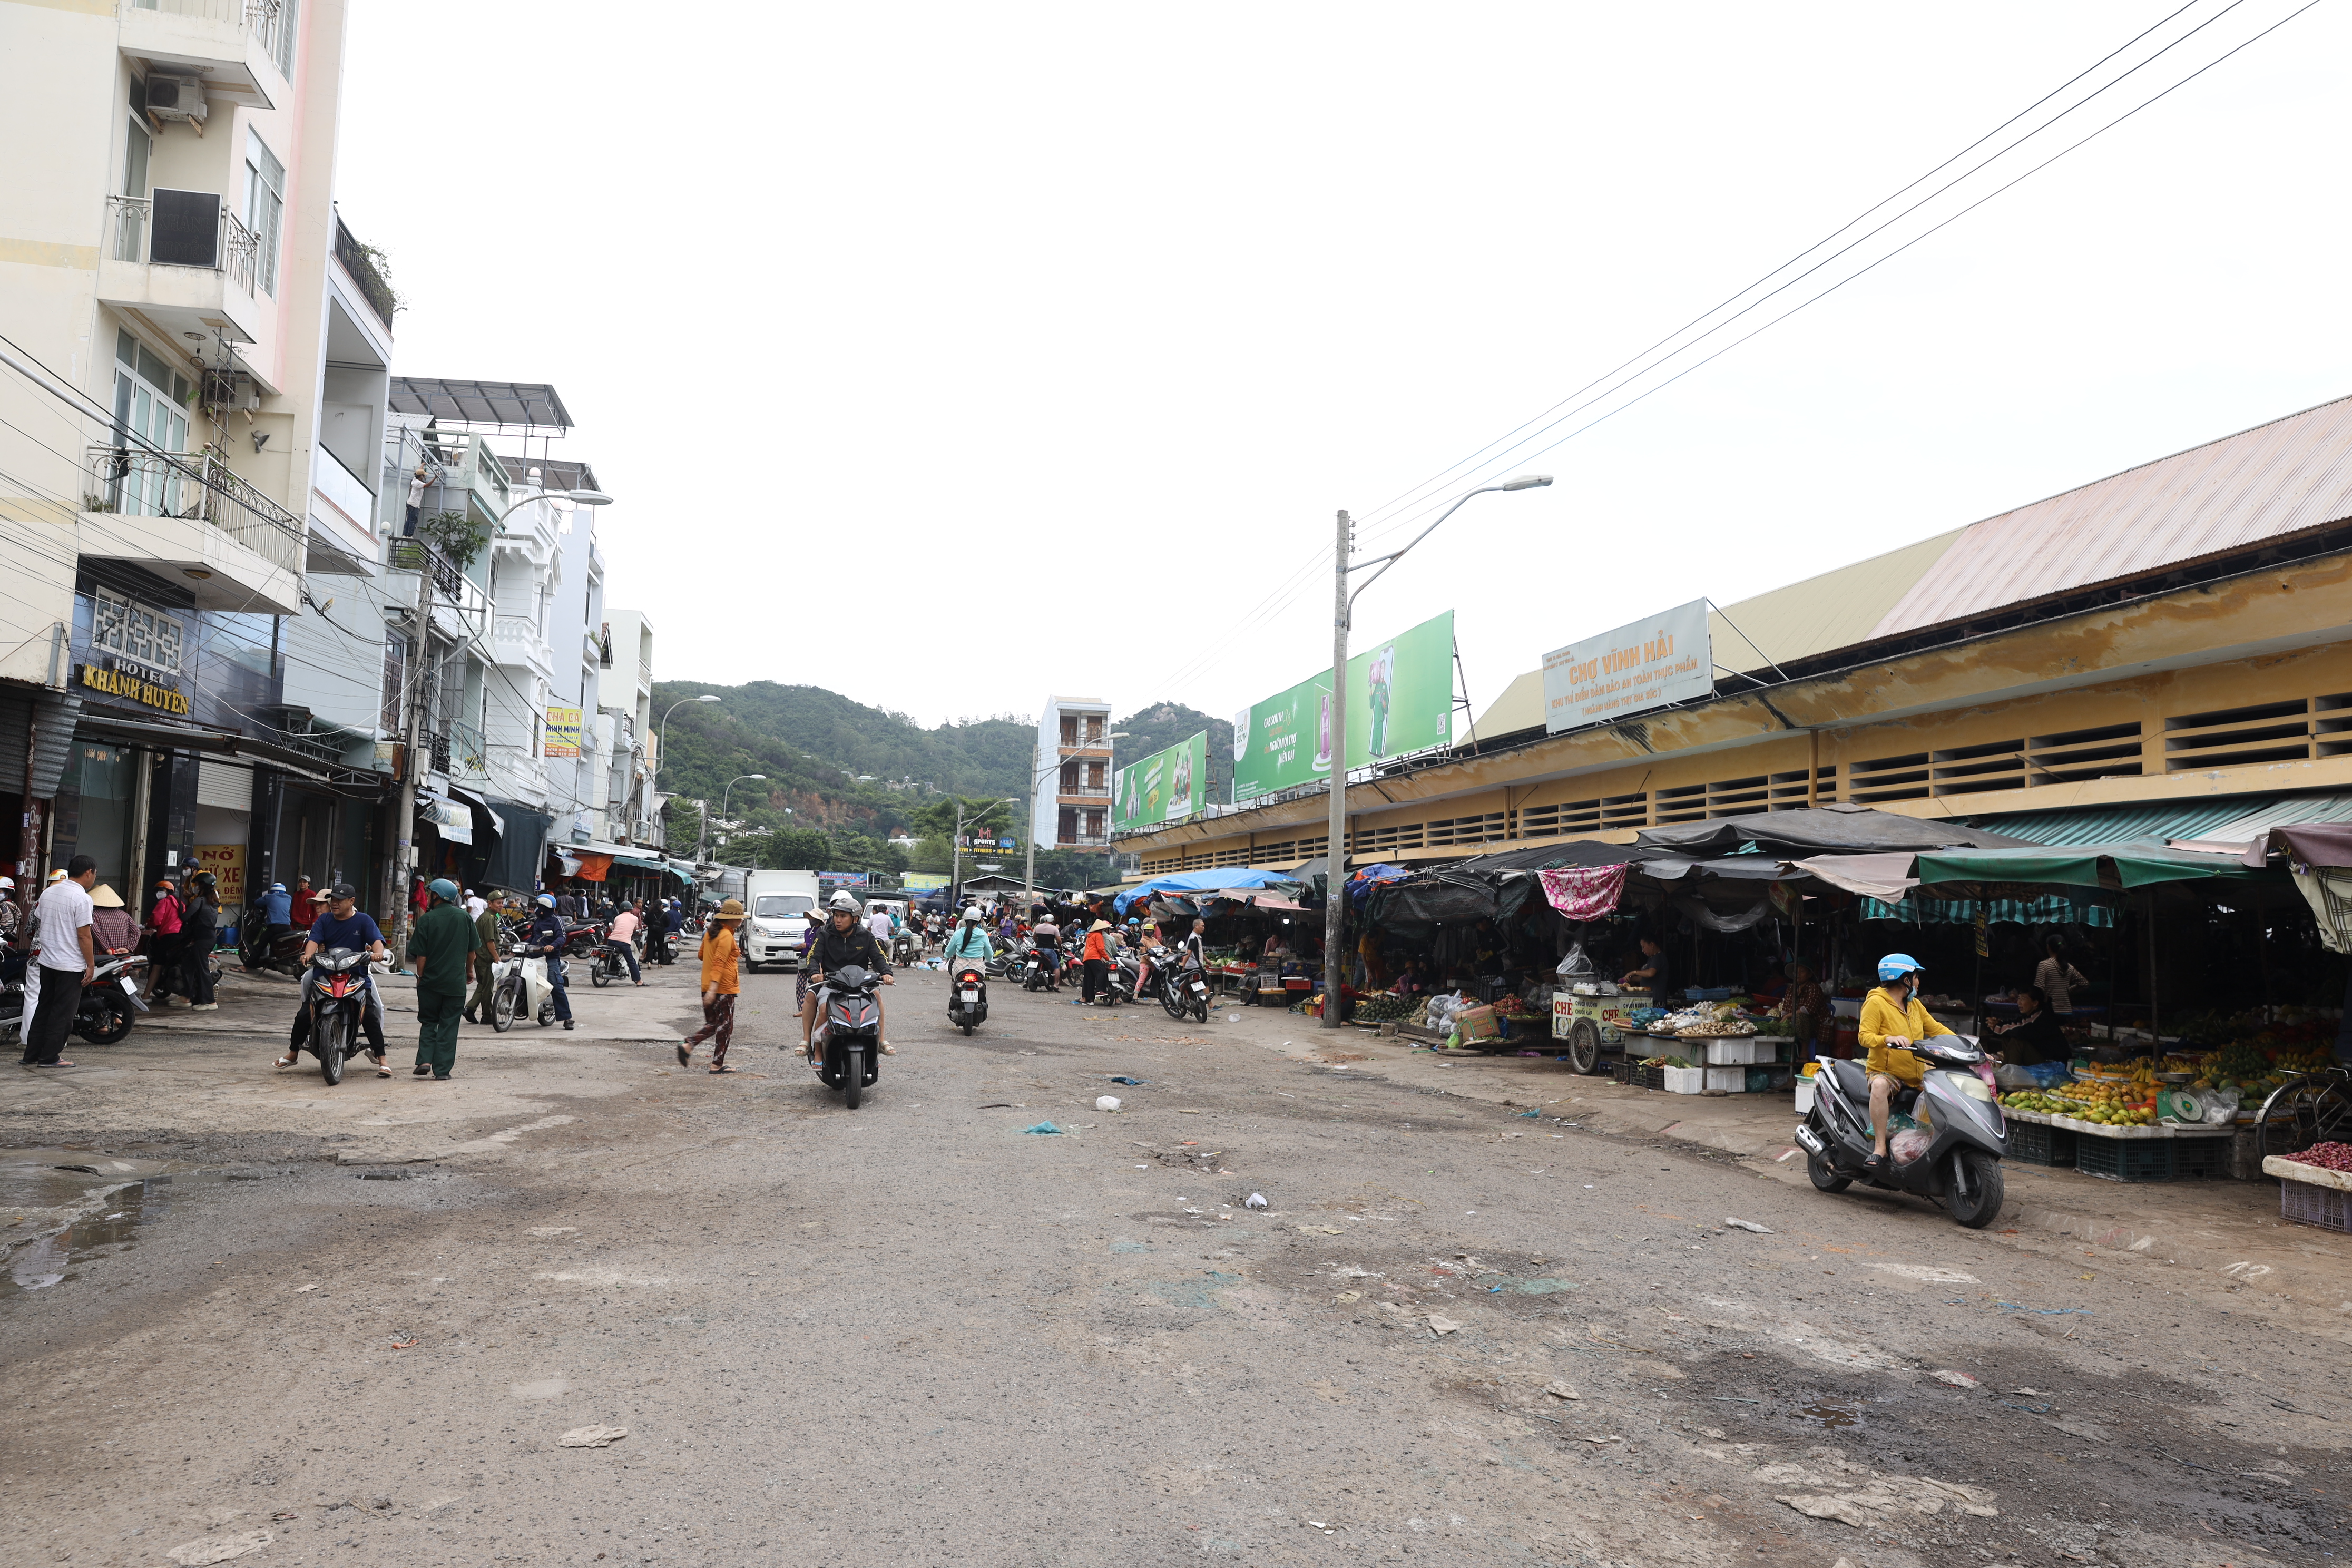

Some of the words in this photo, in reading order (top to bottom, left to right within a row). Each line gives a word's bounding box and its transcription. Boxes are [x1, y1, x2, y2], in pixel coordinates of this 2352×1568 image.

[1570, 658, 1598, 684] CHỢ
[1602, 648, 1640, 674] VĨNH
[1644, 630, 1673, 663] HẢI
[115, 658, 168, 686] HOTEL
[82, 663, 141, 700] KHÁNH
[1552, 697, 1563, 709] KHU
[1564, 690, 1573, 705] THÍ
[1575, 687, 1589, 701] ĐIỂM
[1606, 683, 1620, 694] BẢO
[1622, 679, 1632, 689] AN
[1633, 670, 1652, 687] TOÀN
[1654, 664, 1673, 681] THỰC
[1675, 654, 1698, 674] PHẨM
[1604, 698, 1620, 711] HÀNG
[1634, 691, 1644, 702] GIA
[546, 709, 565, 722] CHẢ
[568, 711, 580, 723] CÁ
[1271, 711, 1283, 726] SOUTH
[546, 724, 562, 733] MINH
[563, 725, 580, 734] MINH
[1237, 732, 1247, 744] SOUTH
[1269, 737, 1281, 752] NGƯỜI
[1289, 731, 1297, 747] TRỢ
[1279, 750, 1288, 766] HIỆN
[201, 846, 235, 861] NỞ
[222, 867, 240, 883] XE
[23, 883, 36, 905] XE
[224, 885, 243, 894] ĐÊM
[1554, 998, 1573, 1016] CHÈ
[1602, 1005, 1620, 1022] CHÈ
